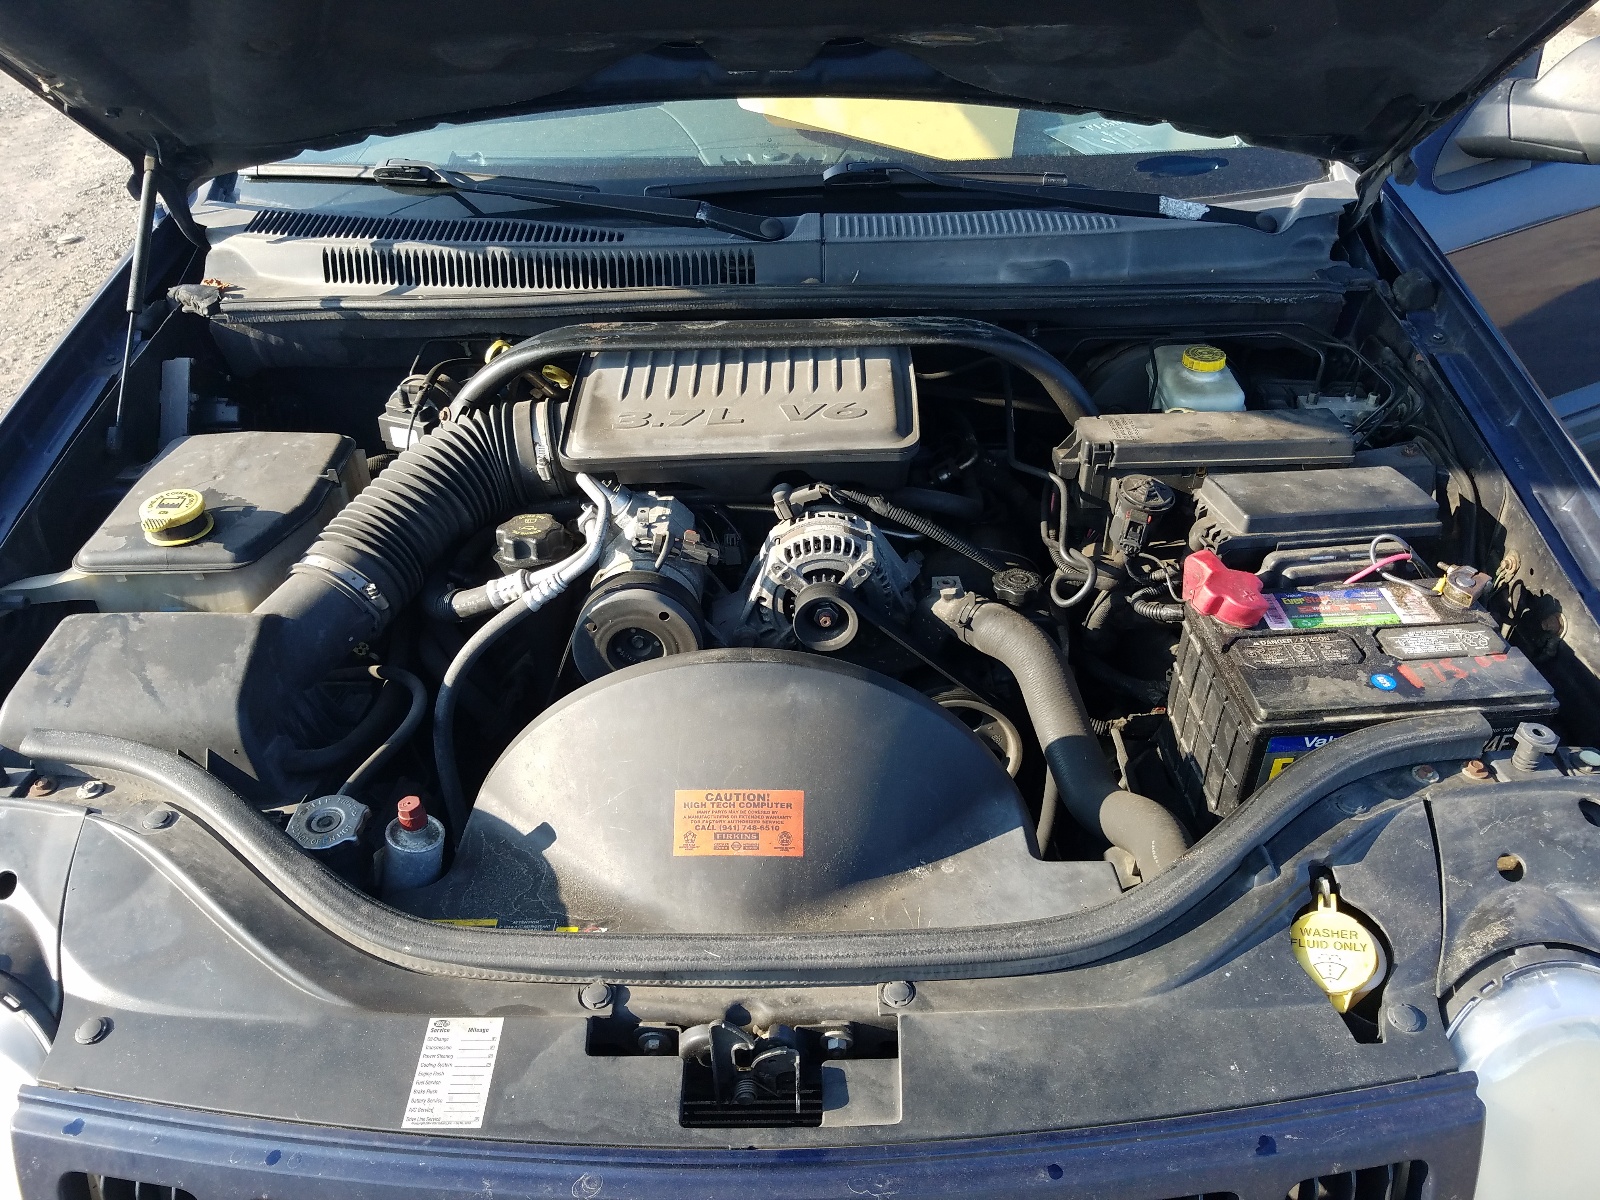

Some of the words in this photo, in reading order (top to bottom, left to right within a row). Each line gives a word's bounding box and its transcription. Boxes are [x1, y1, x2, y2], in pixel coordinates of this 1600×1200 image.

[611, 408, 746, 431] 3.7L
[778, 402, 868, 422] V6
[1304, 735, 1338, 748] Val
[1484, 734, 1514, 752] 4F
[705, 792, 771, 802] CAUTION!
[738, 802, 793, 810] COMPUTER
[719, 825, 740, 833] (941)
[1300, 927, 1359, 940] WASHER
[1291, 938, 1329, 950] FLUID
[1333, 941, 1368, 953] ONLY
